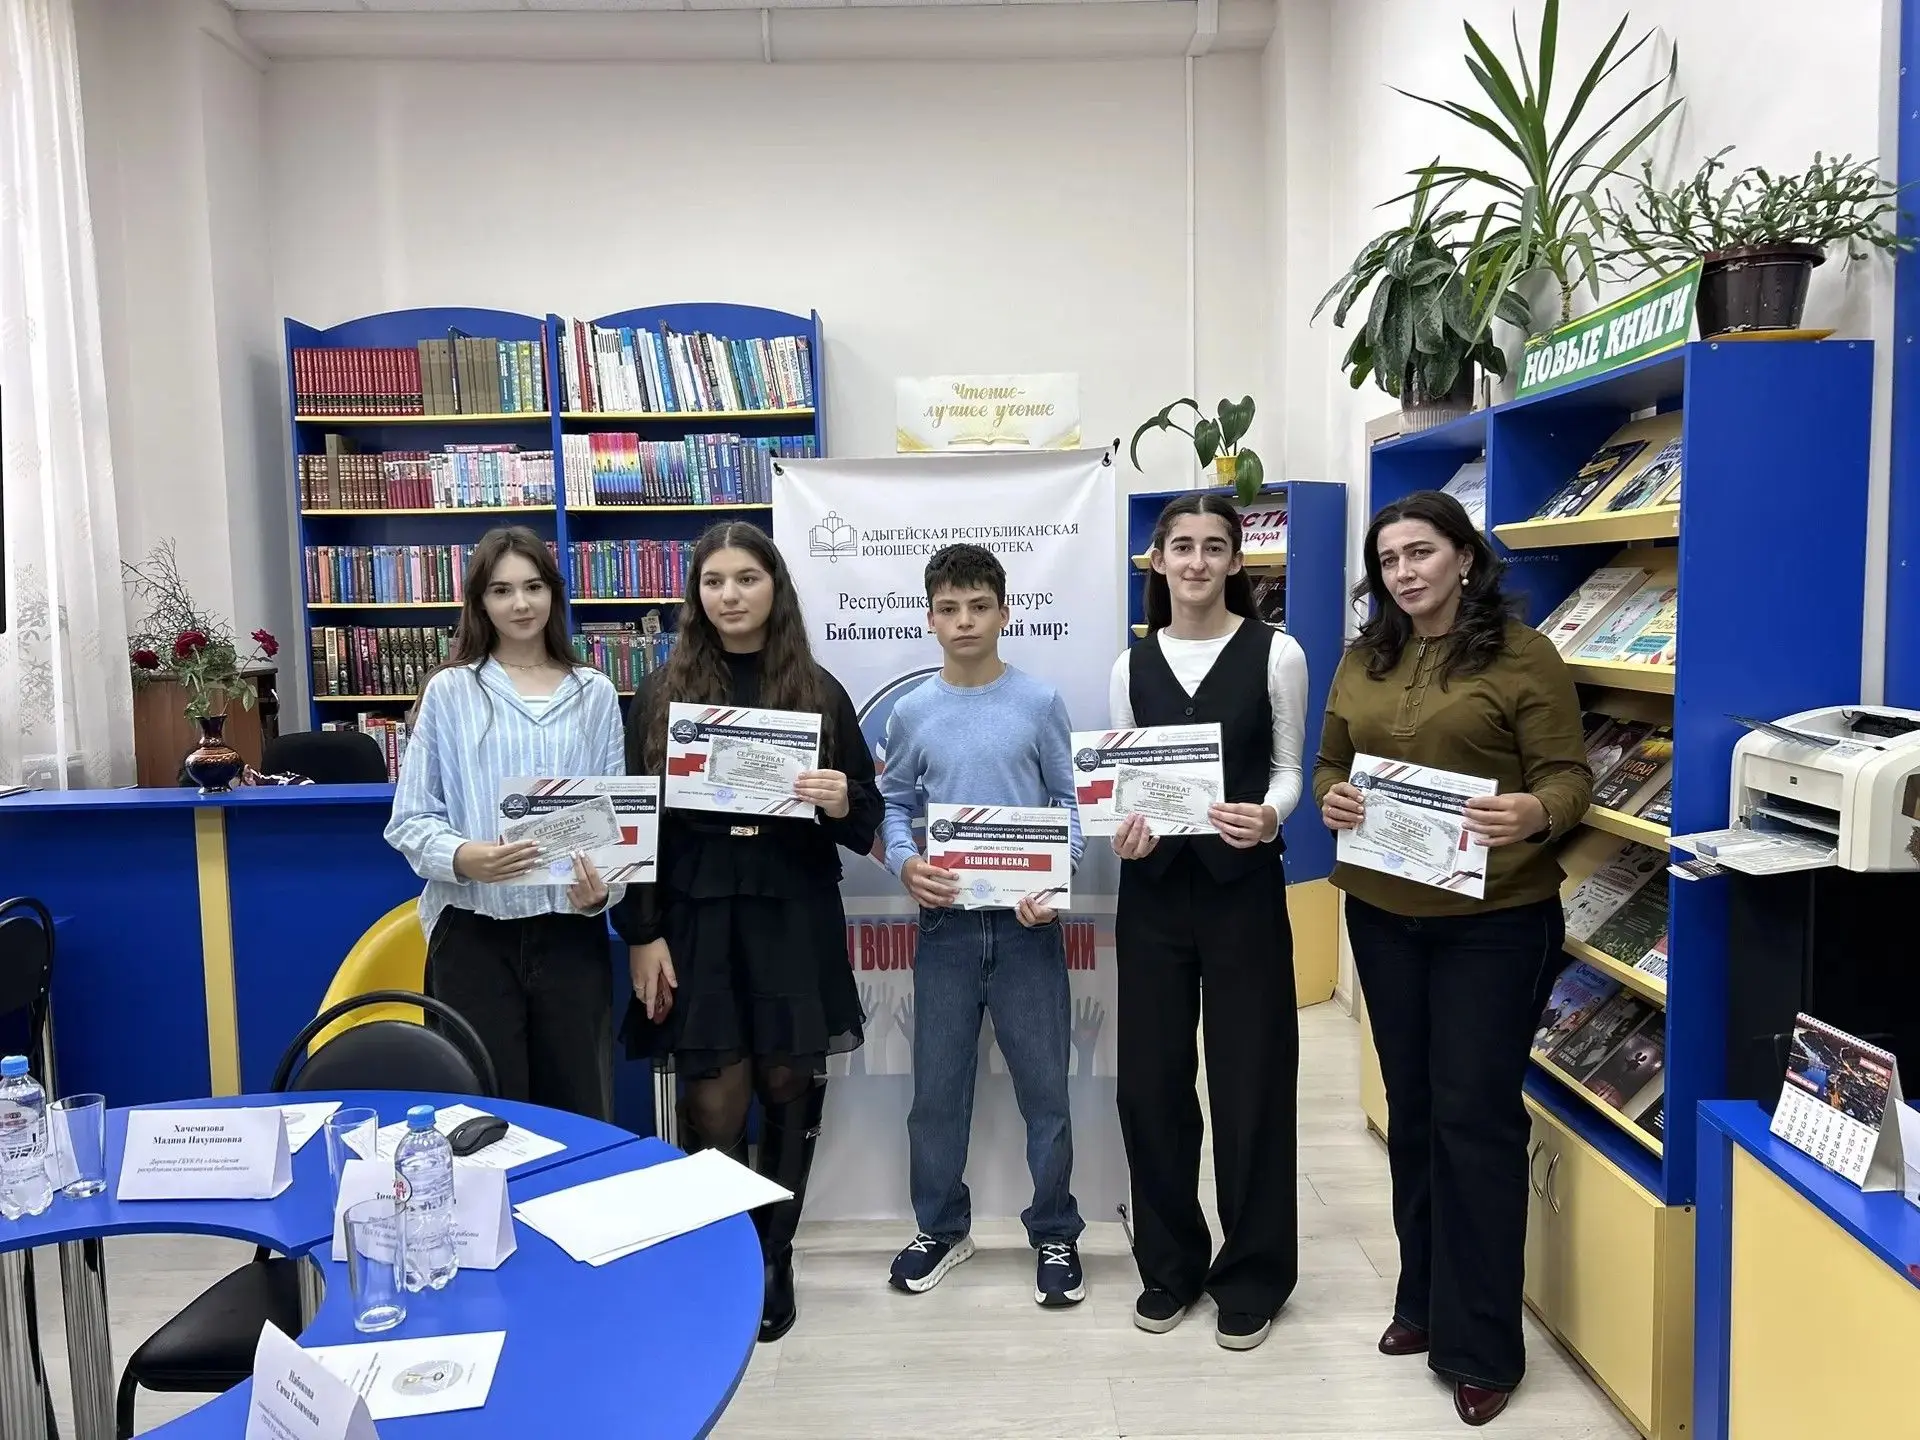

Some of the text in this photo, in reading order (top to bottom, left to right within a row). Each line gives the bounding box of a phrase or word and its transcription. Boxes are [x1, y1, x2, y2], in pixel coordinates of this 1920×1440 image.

[1521, 282, 1692, 389] НОВЫЕ КНИГИ
[922, 401, 1055, 429] лучшее учение
[861, 522, 1079, 542] АДЫГЕЙСКАЯ РЕСПУБЛИКАНСКАЯ
[838, 591, 930, 612] Республика
[825, 621, 923, 642] Библиотека
[1029, 620, 1070, 641] мир:
[736, 751, 785, 764] СЕРТИФИКАТ
[1142, 781, 1191, 794] СЕРТИФИКАТ
[533, 814, 586, 837] СЕРТИФИКАТ
[1385, 810, 1433, 833] СЕРТИФИКАТ
[1002, 857, 1030, 868] АСХАД
[152, 1136, 186, 1145] Мадина
